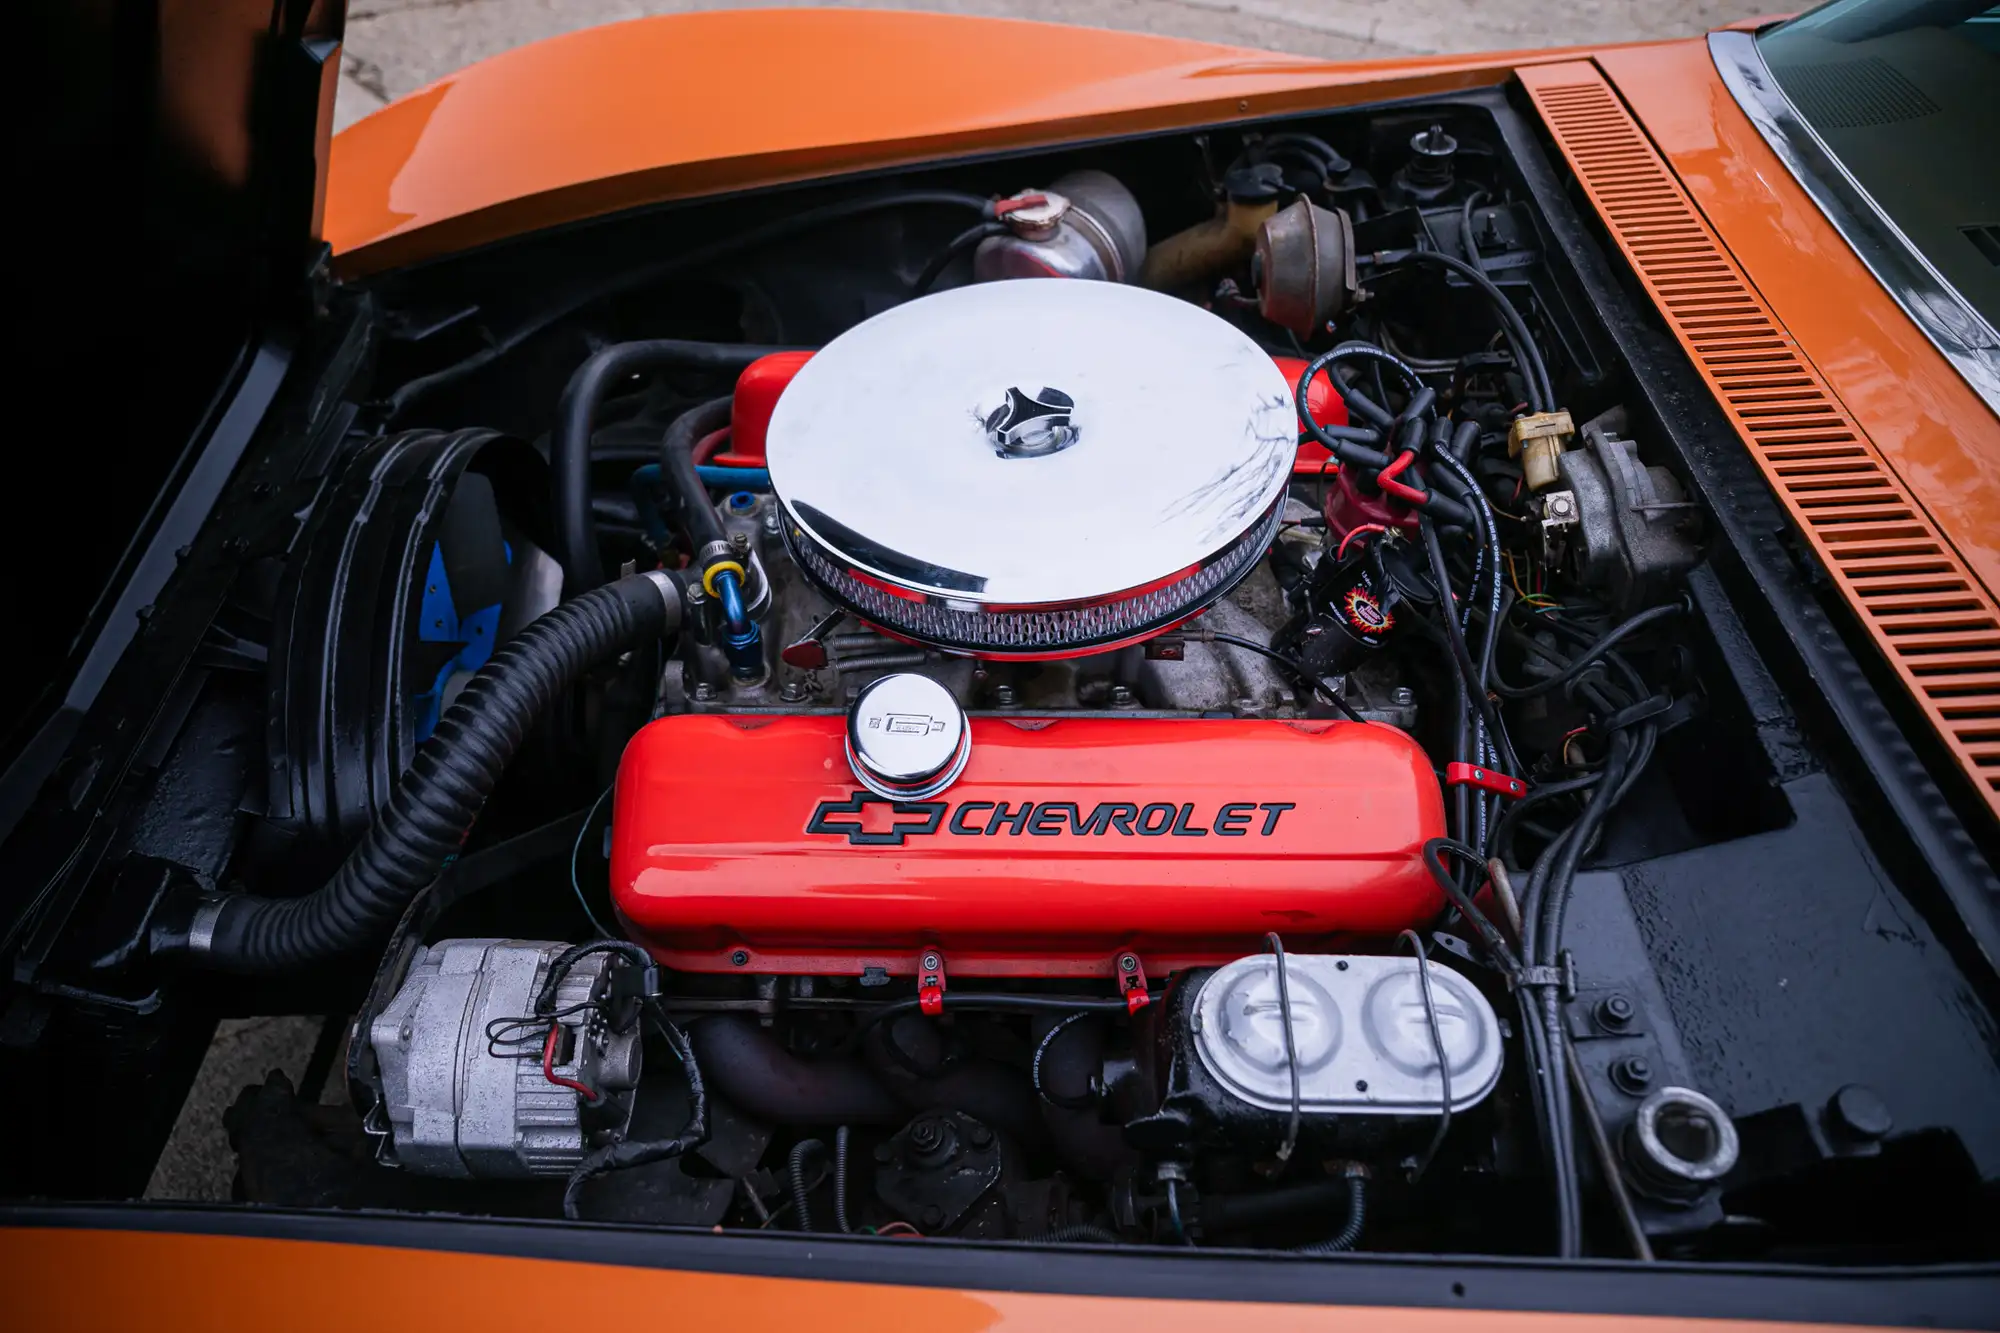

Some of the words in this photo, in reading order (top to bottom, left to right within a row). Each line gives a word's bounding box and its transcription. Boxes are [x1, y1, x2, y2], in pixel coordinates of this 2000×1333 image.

[1455, 463, 1481, 495] SILICONE
[1488, 520, 1498, 541] WIRE
[1492, 572, 1501, 612] TAYLOR
[949, 801, 1296, 837] CHEVROLET
[1033, 1049, 1043, 1089] RESISTOR
[1042, 1026, 1060, 1046] CORE
